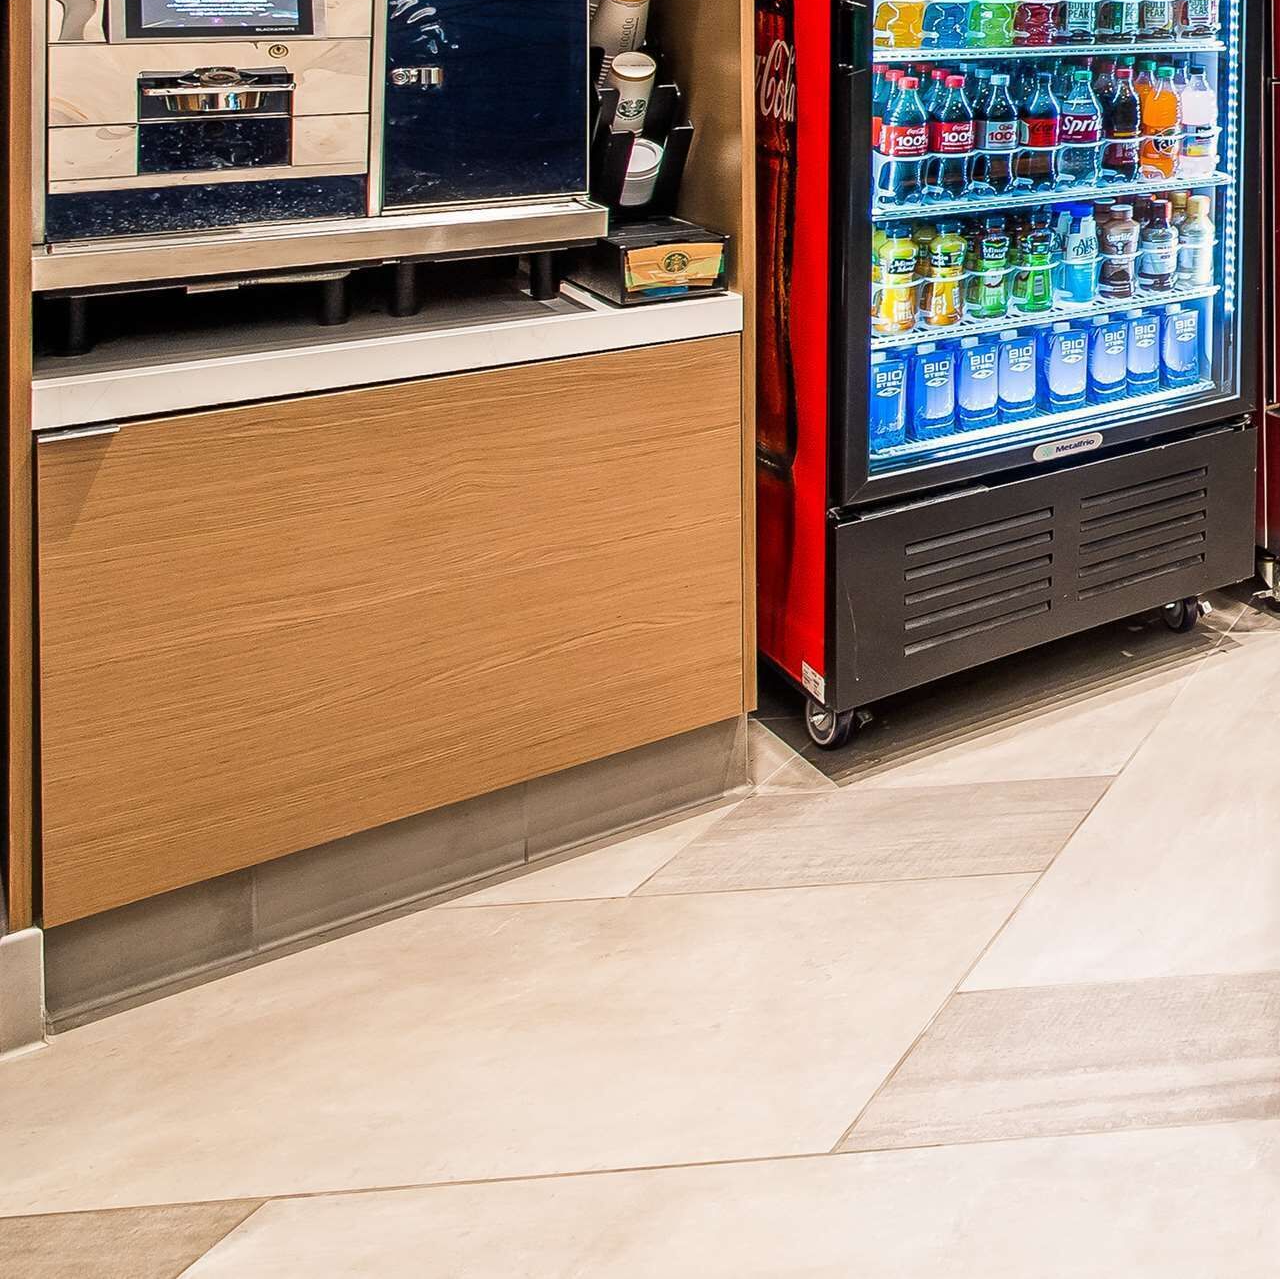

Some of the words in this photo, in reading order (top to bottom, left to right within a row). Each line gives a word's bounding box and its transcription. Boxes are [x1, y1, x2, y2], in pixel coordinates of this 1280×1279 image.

[1068, 9, 1090, 19] PEAK
[1145, 8, 1165, 18] PEAK
[1063, 115, 1103, 134] Sprit
[1134, 324, 1156, 335] BIO
[1175, 320, 1195, 330] BIO
[1104, 330, 1125, 342] BIO
[1061, 339, 1085, 349] BIO
[1008, 346, 1033, 359] BIO
[970, 353, 995, 365] BIO
[924, 361, 950, 373] BIO
[876, 370, 902, 382] BIO
[1055, 438, 1095, 453] Metalfrio
